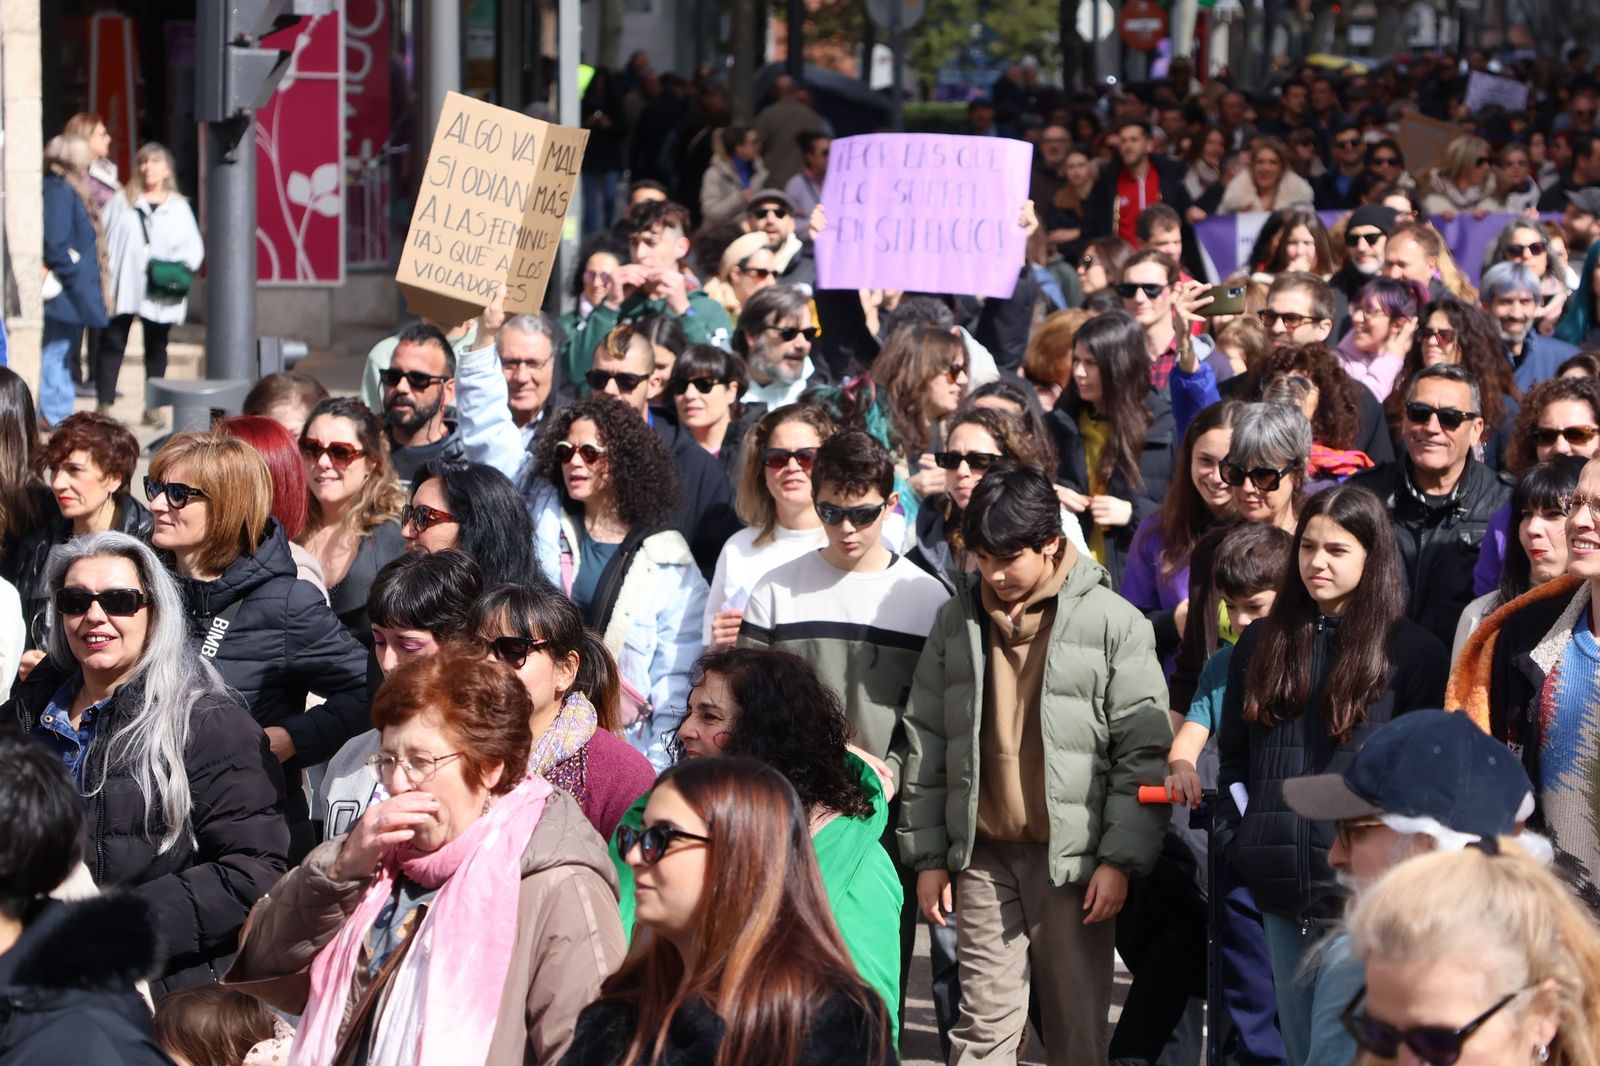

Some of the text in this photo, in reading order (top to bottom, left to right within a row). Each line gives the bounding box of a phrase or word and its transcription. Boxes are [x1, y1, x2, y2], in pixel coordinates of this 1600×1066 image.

[444, 111, 578, 176] ALGO VA MAL
[903, 142, 947, 170] LAS
[429, 155, 457, 189] SI
[533, 183, 570, 219] MÁS
[418, 195, 436, 224] A
[443, 203, 487, 237] LAS
[413, 229, 544, 280] TAS QUE A LOS
